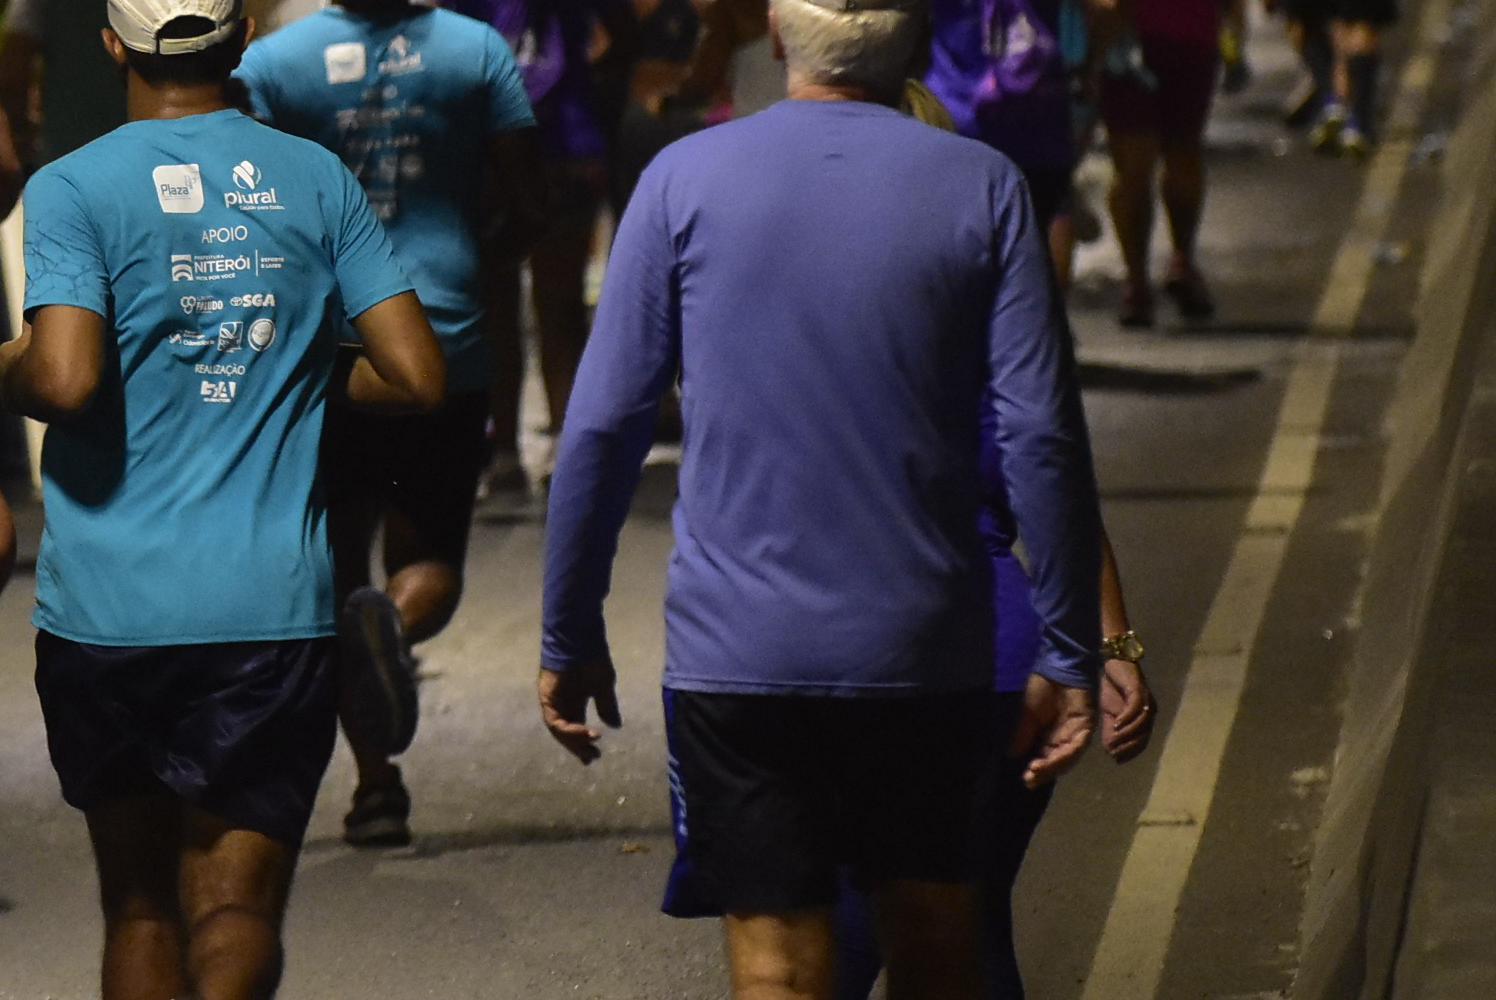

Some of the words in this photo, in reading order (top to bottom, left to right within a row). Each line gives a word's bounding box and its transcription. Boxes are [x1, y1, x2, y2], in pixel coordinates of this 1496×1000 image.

[160, 183, 190, 196] Plaza
[224, 188, 277, 208] plural
[202, 225, 249, 244] APOIO
[194, 255, 251, 273] NITERÓI
[242, 293, 276, 308] SGA
[195, 363, 246, 376] REALIZAÇÃO
